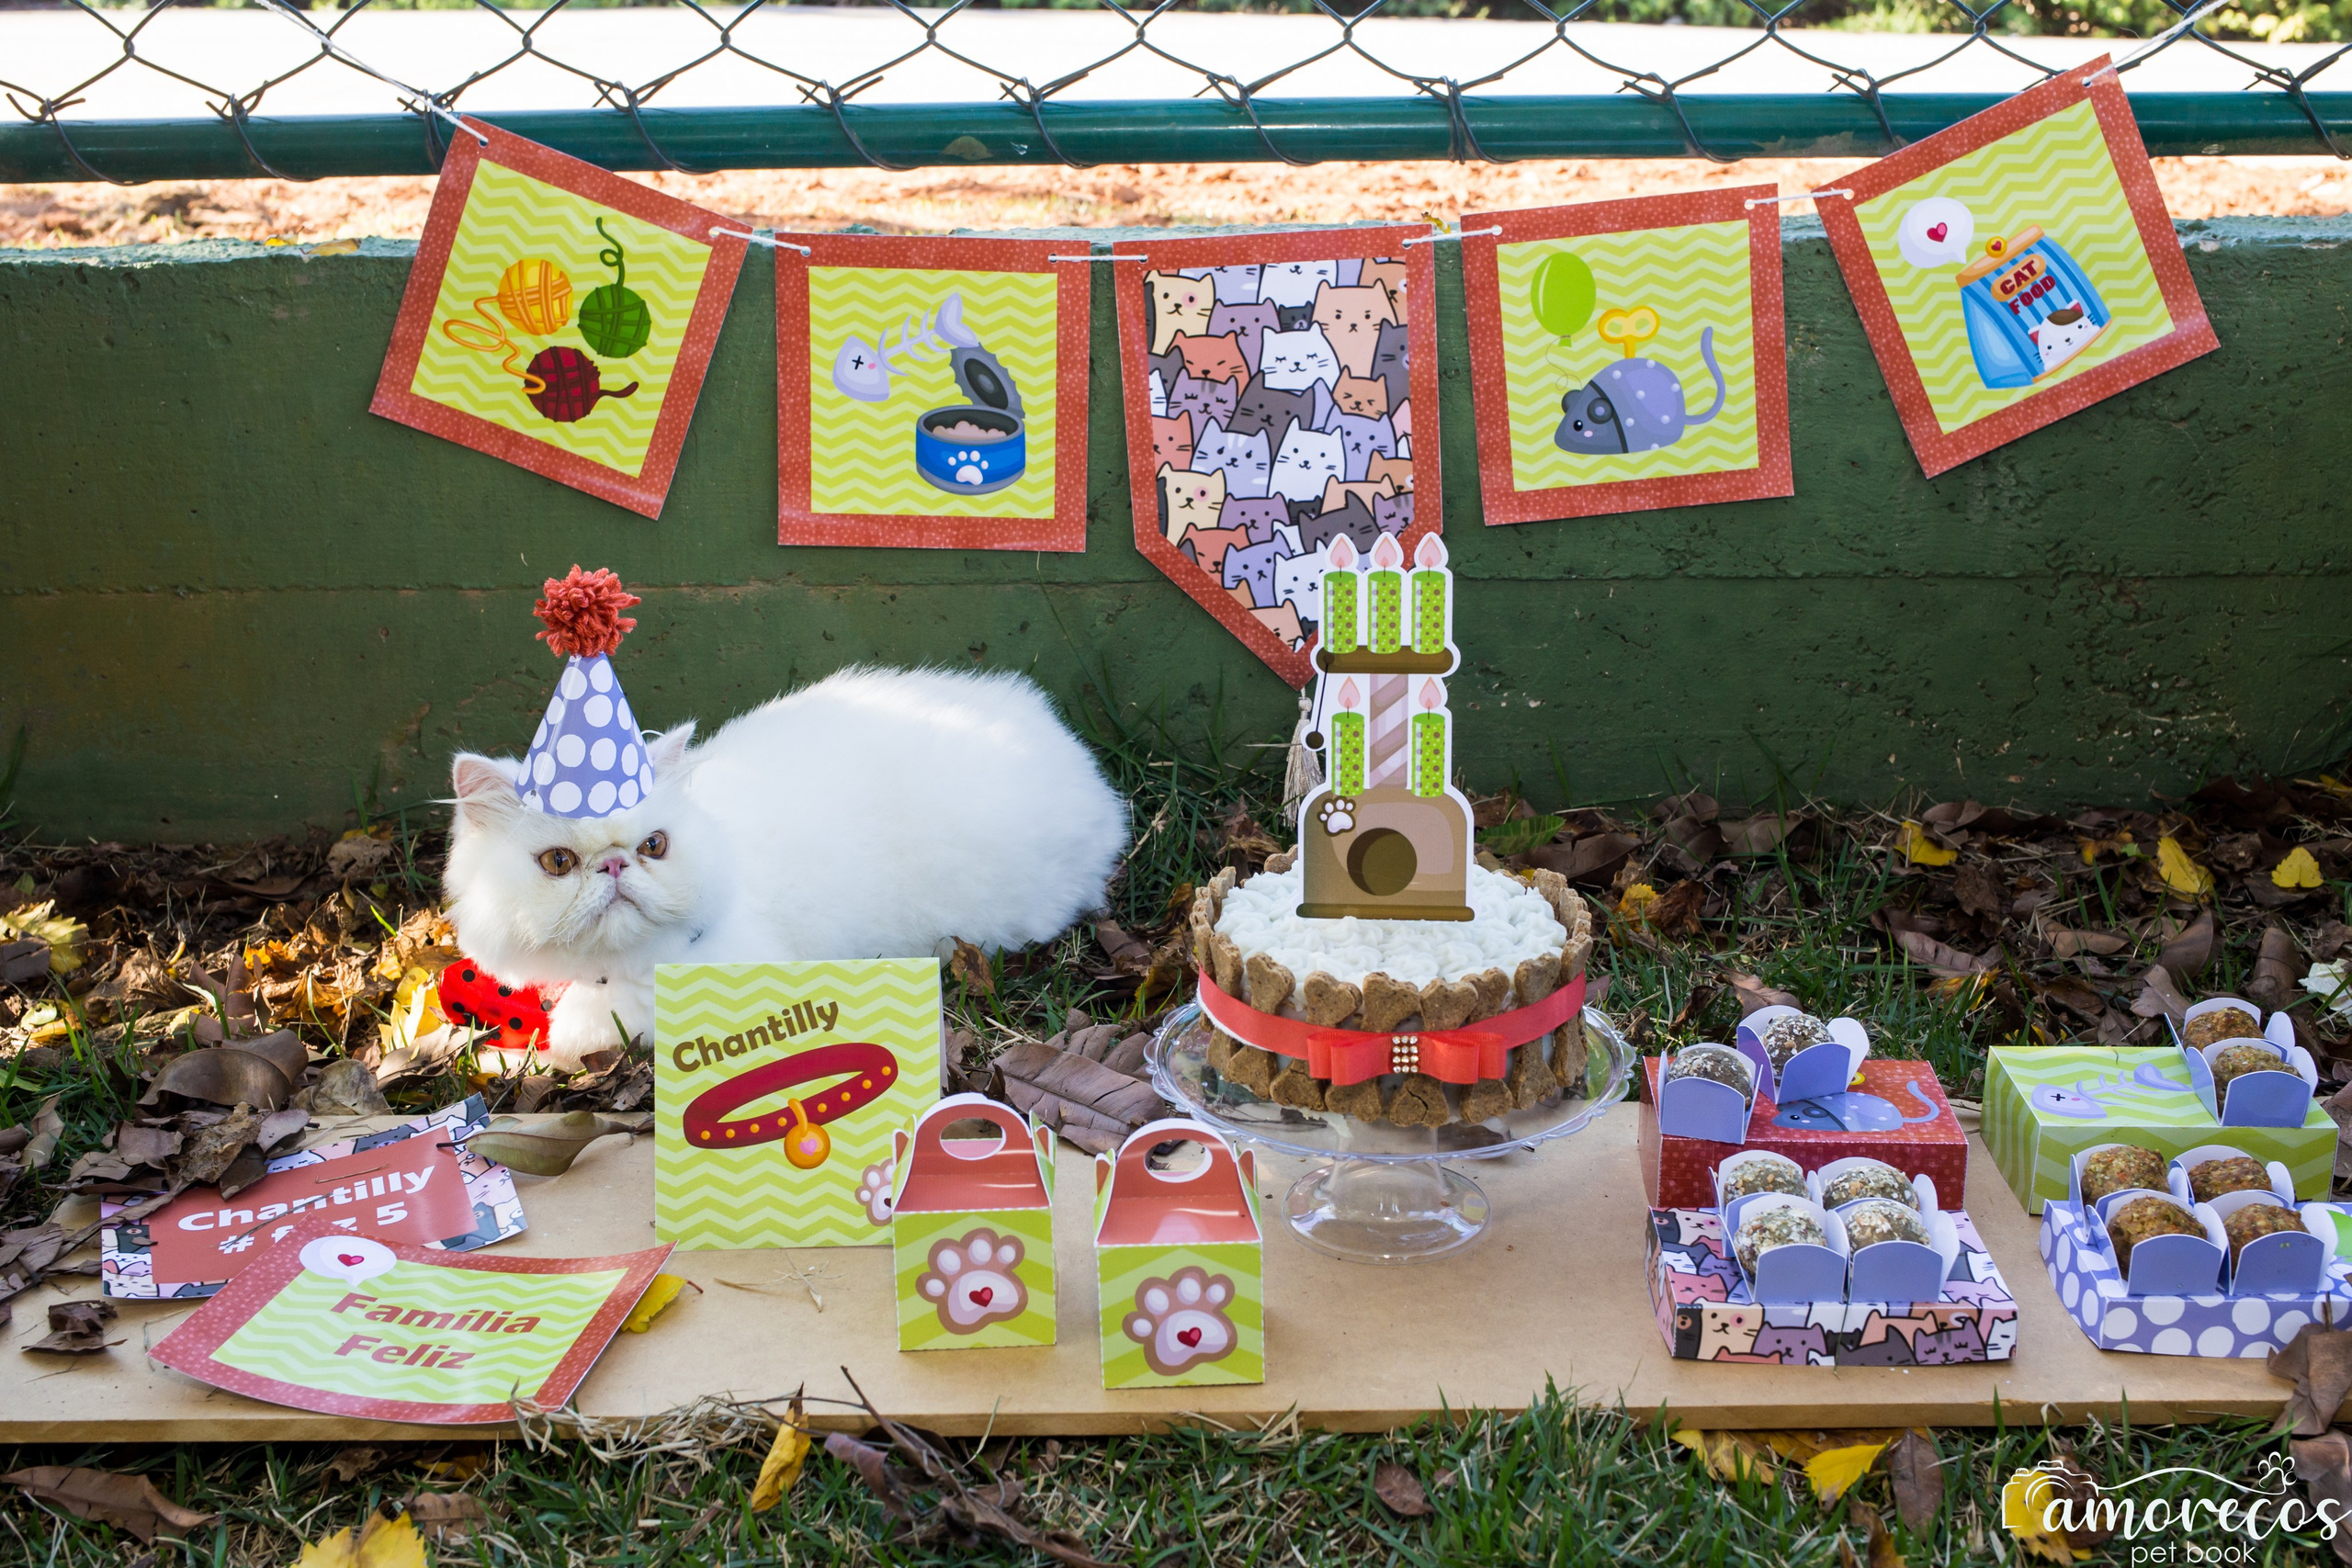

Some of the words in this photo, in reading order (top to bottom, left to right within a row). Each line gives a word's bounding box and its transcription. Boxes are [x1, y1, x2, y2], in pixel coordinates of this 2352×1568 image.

[1999, 259, 2038, 295] CAT
[2008, 275, 2056, 316] FOOD
[673, 999, 839, 1073] Chantilly
[177, 1165, 435, 1231] Chantilly
[270, 1216, 358, 1244] fz
[376, 1201, 408, 1226] 5
[334, 1334, 476, 1369] Feliz
